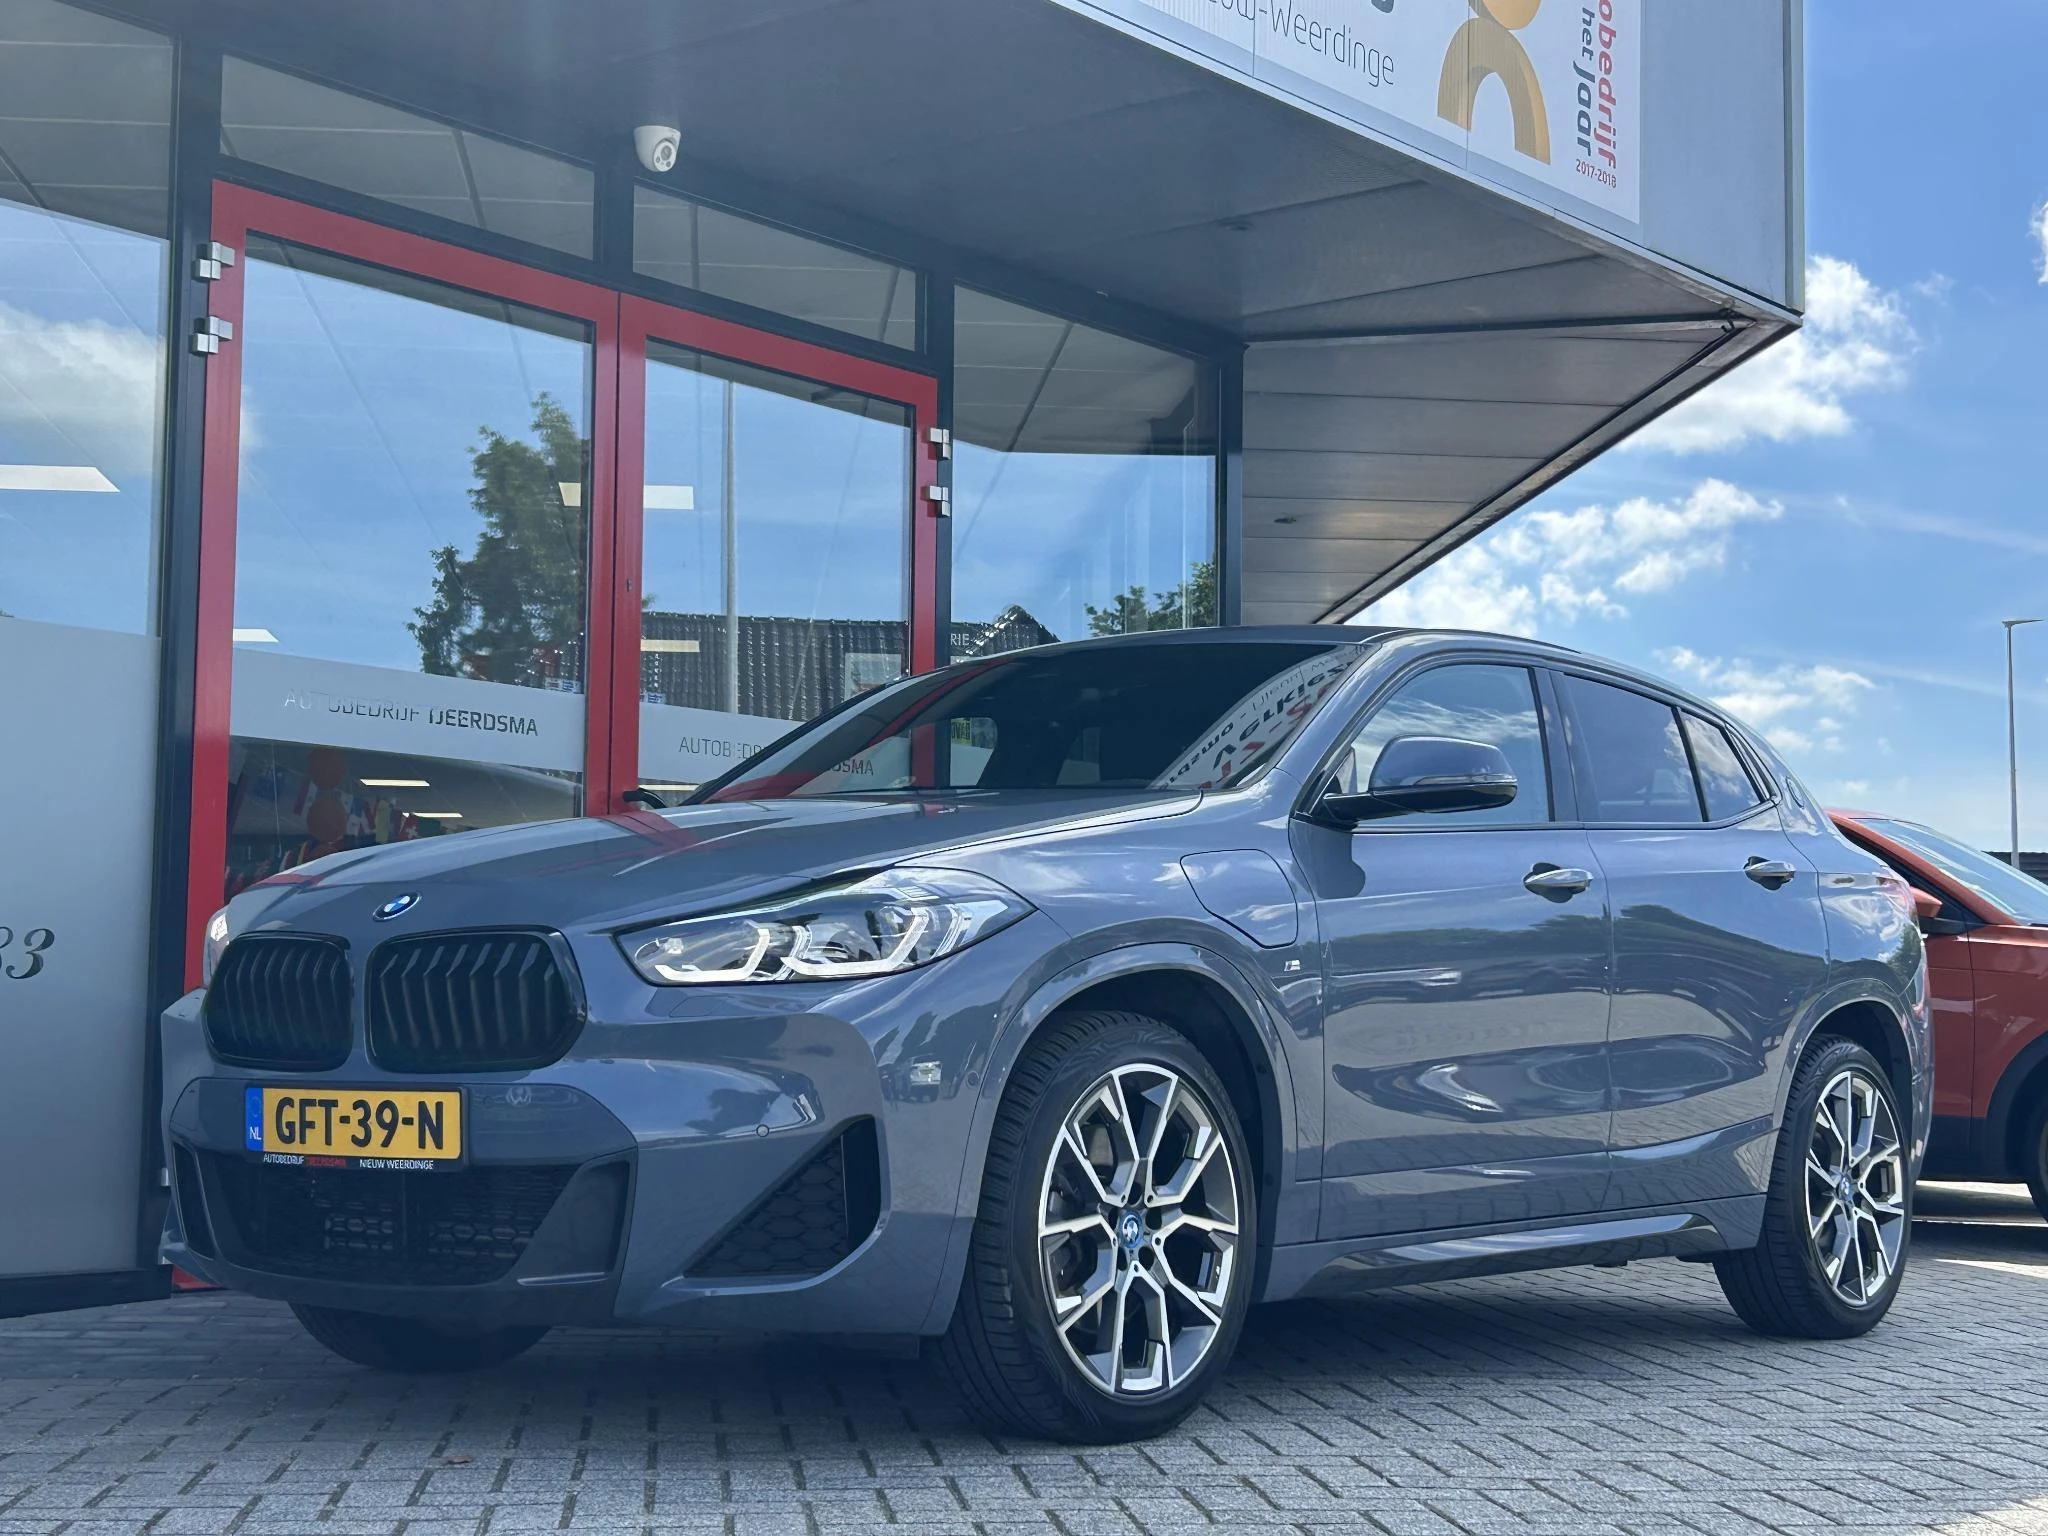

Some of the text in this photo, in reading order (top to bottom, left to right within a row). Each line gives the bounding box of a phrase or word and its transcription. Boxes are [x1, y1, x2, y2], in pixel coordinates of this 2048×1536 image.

[1581, 7, 1596, 61] het
[1575, 158, 1617, 189] 2017-2018
[249, 1126, 262, 1141] NL
[275, 1096, 445, 1150] GFT-39-N
[359, 1158, 385, 1169] NIEUW
[387, 1159, 434, 1170] WEERDINGE
